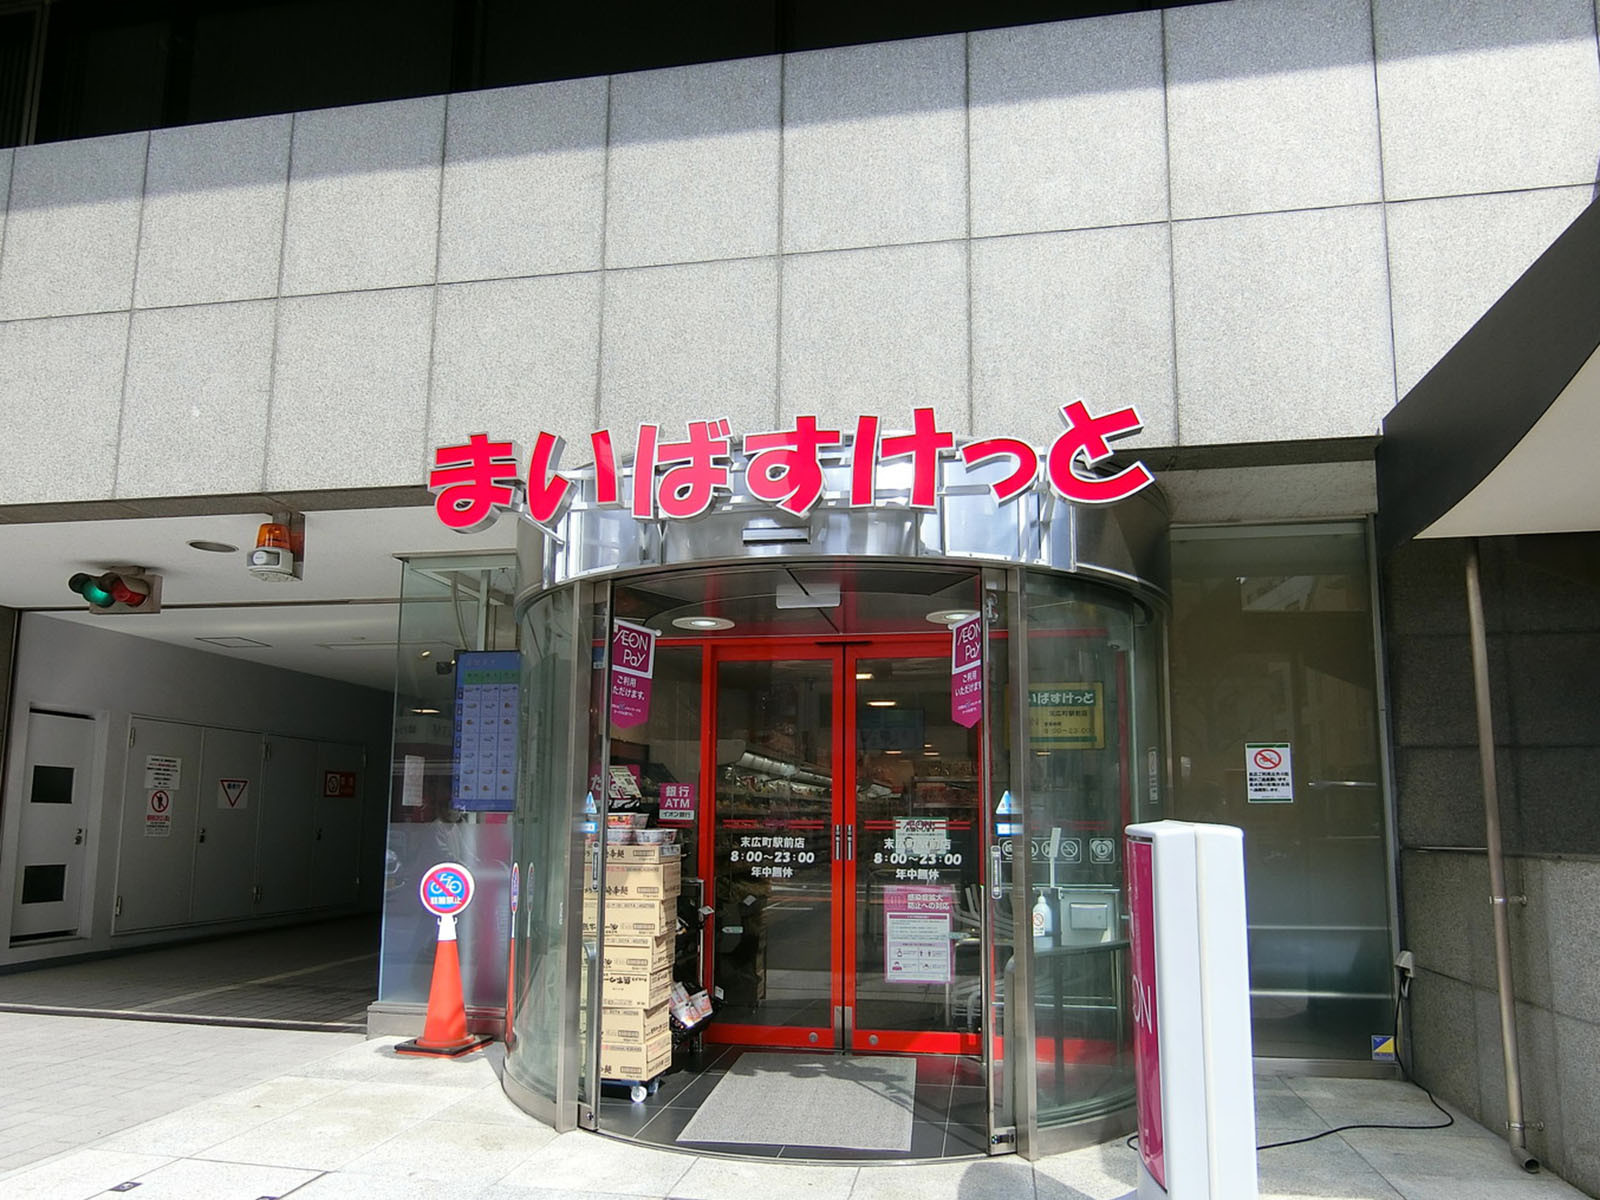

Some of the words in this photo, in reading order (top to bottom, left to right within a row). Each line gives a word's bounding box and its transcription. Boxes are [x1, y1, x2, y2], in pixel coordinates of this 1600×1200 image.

[428, 401, 1155, 530] まいばすけっと
[623, 650, 646, 667] Pay
[617, 676, 637, 688] ご利用
[666, 786, 690, 797] 銀行
[665, 798, 690, 808] ATM
[740, 836, 806, 849] 末広町駅前店
[751, 866, 793, 878] 年中無休
[896, 868, 940, 880] 年中無休
